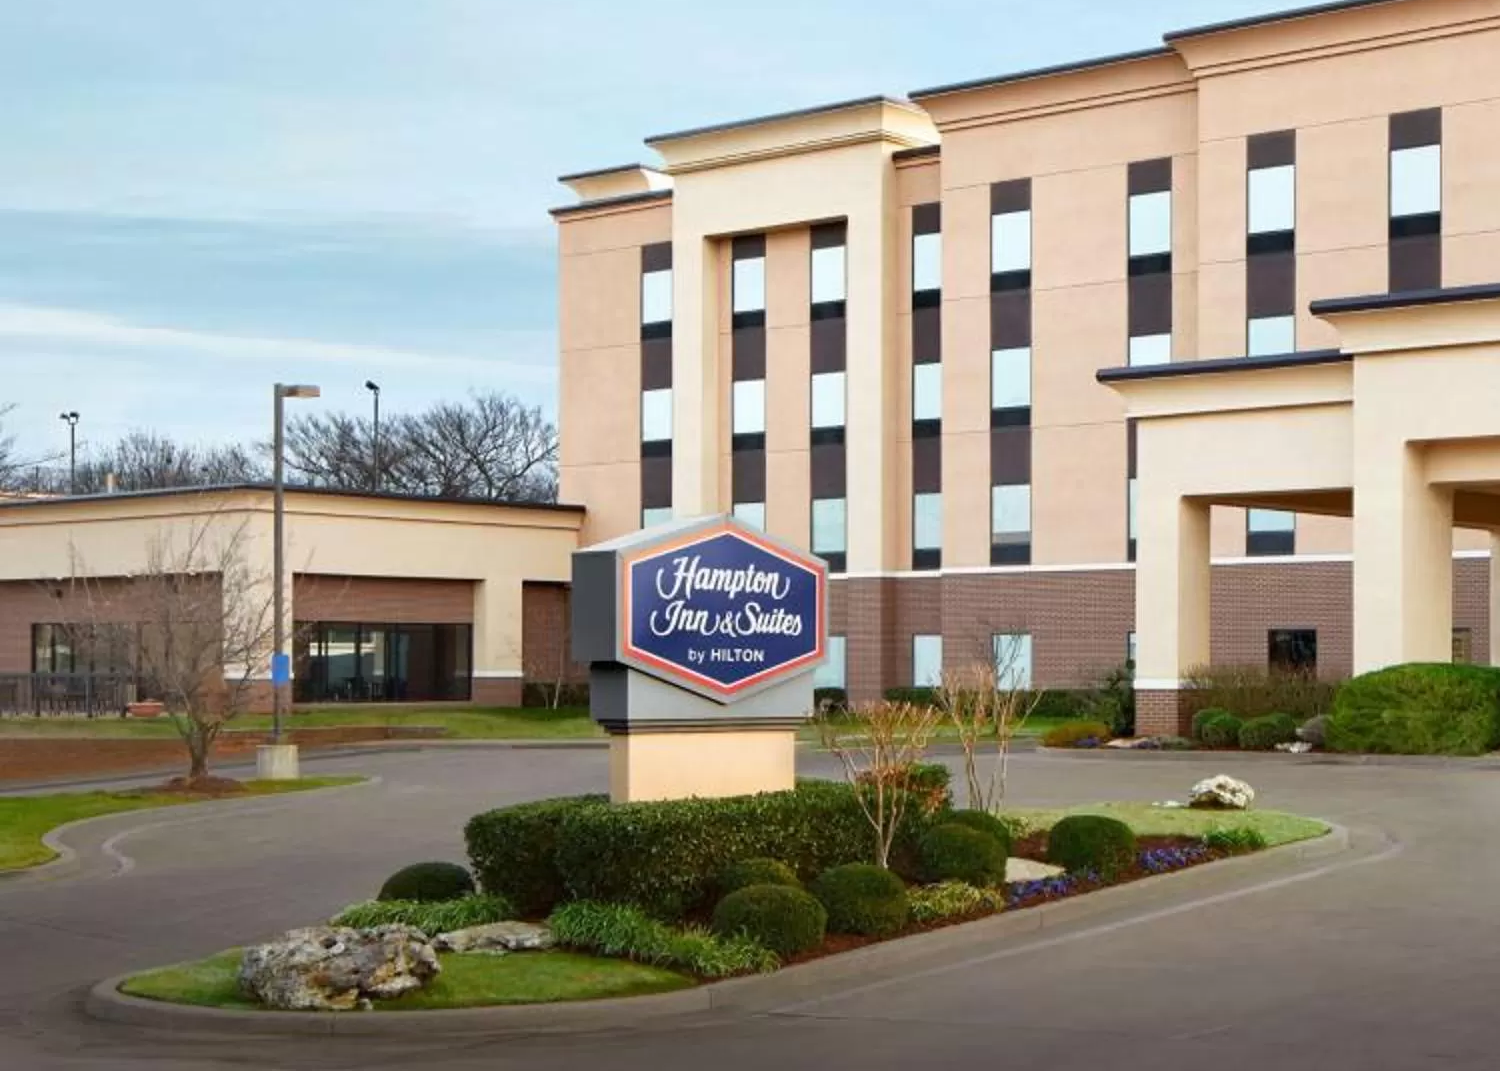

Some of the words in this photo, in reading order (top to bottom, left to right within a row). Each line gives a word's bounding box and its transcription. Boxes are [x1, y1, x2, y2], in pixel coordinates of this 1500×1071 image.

[656, 554, 790, 600] Hampton
[650, 600, 720, 636] Inn
[719, 613, 737, 638] &
[735, 602, 802, 636] Suites
[687, 648, 704, 664] by
[710, 648, 765, 663] HILTON
